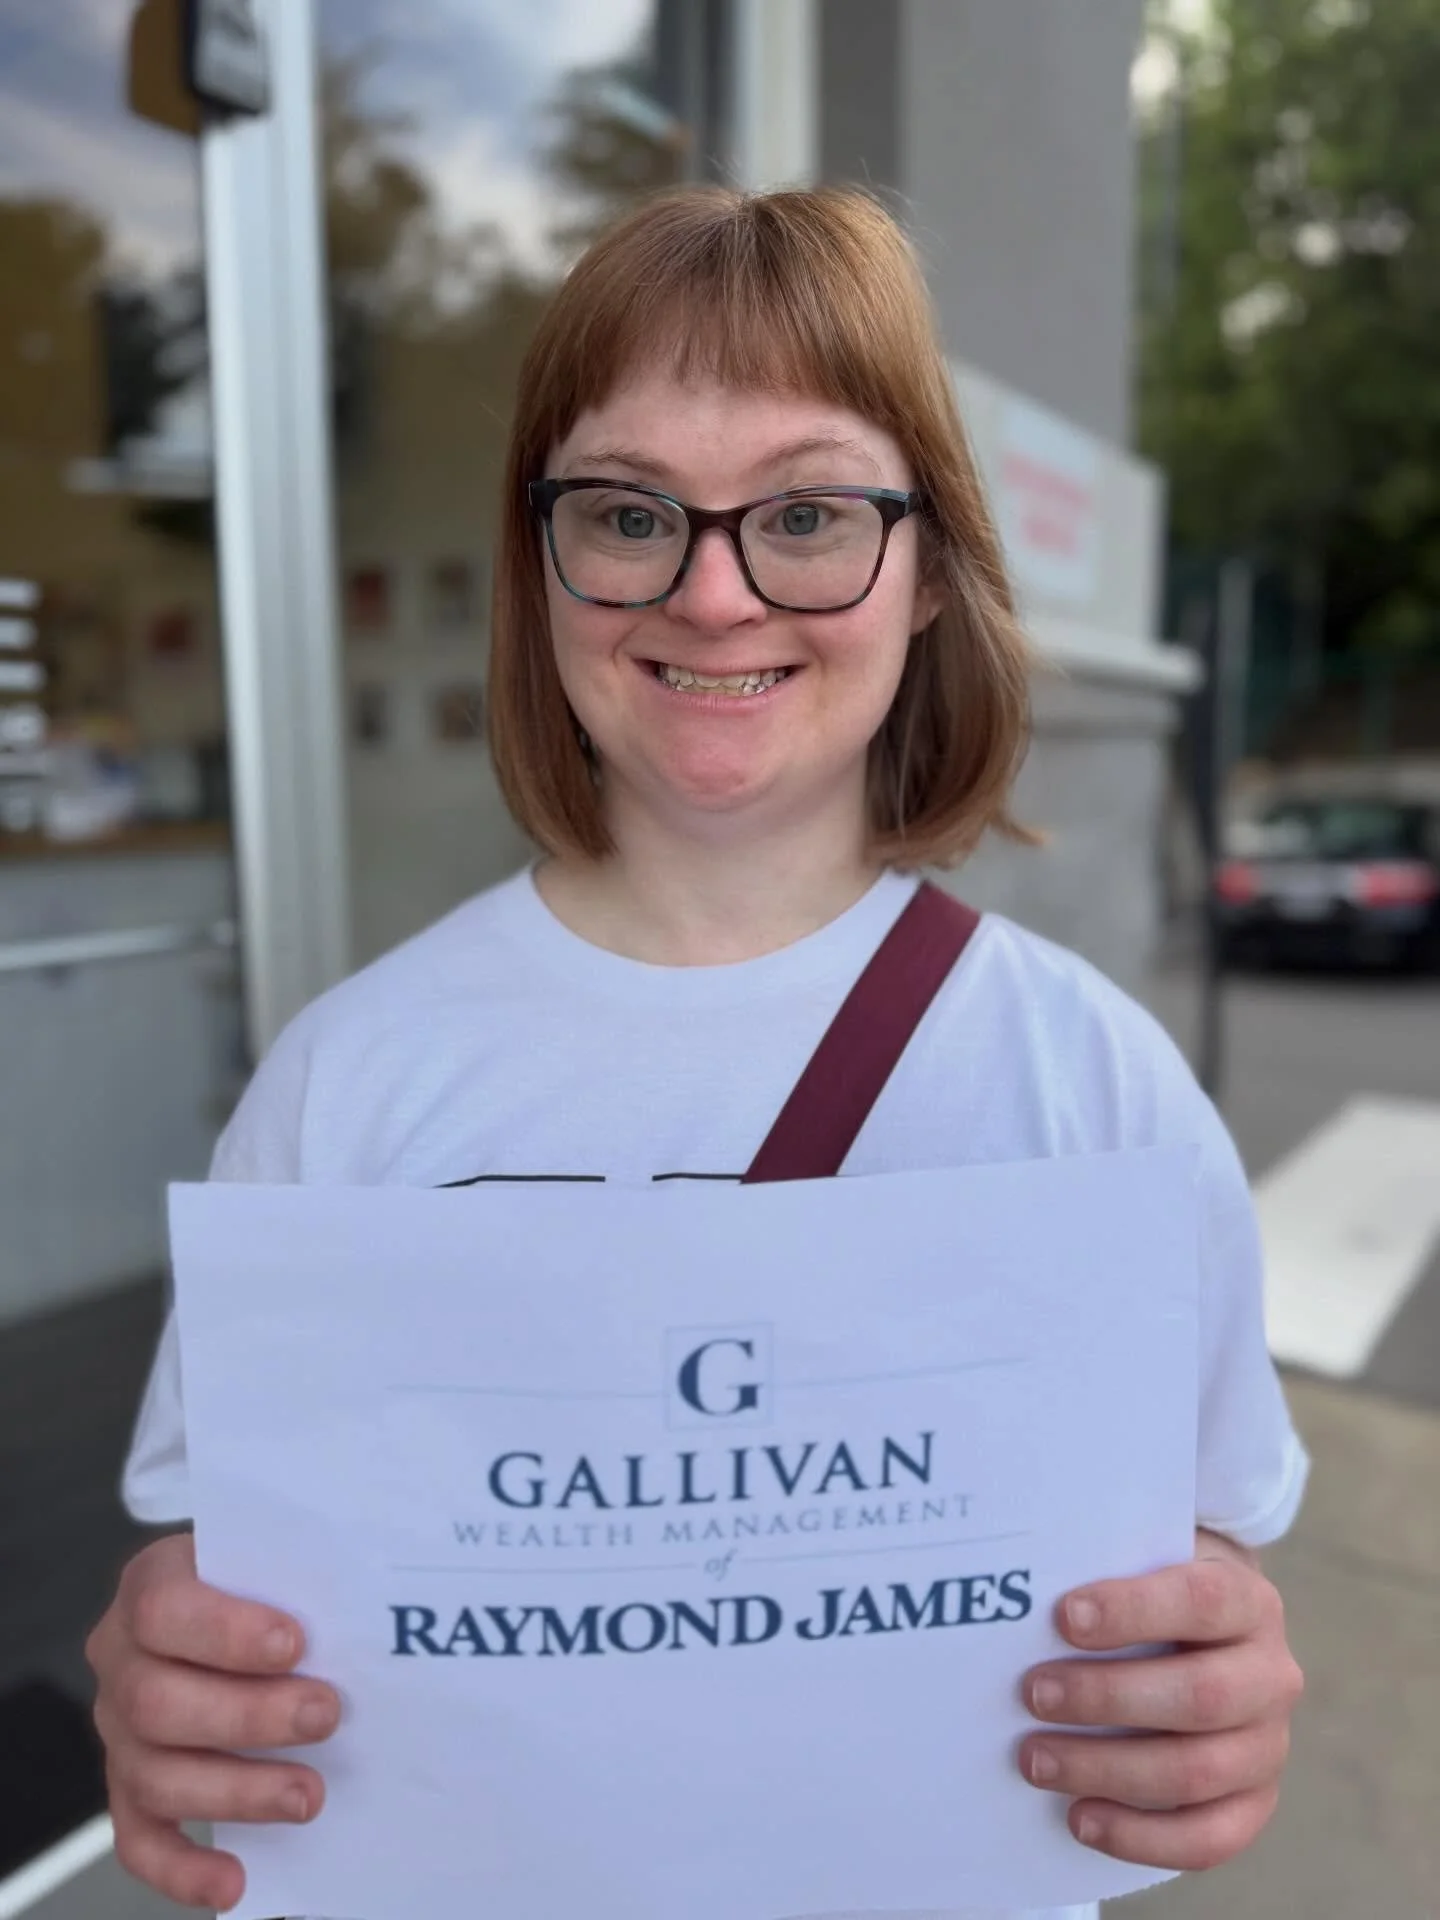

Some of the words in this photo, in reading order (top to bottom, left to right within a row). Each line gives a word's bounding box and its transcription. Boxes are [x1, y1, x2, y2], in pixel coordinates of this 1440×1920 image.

[677, 1339, 763, 1416] G
[488, 1431, 936, 1510] GALLIVAN
[453, 1520, 633, 1549] WEALTH
[661, 1494, 975, 1545] MANAGEMENT
[704, 1549, 737, 1582] of
[388, 1594, 783, 1657] RAYMOND
[796, 1569, 1032, 1640] JAMES
